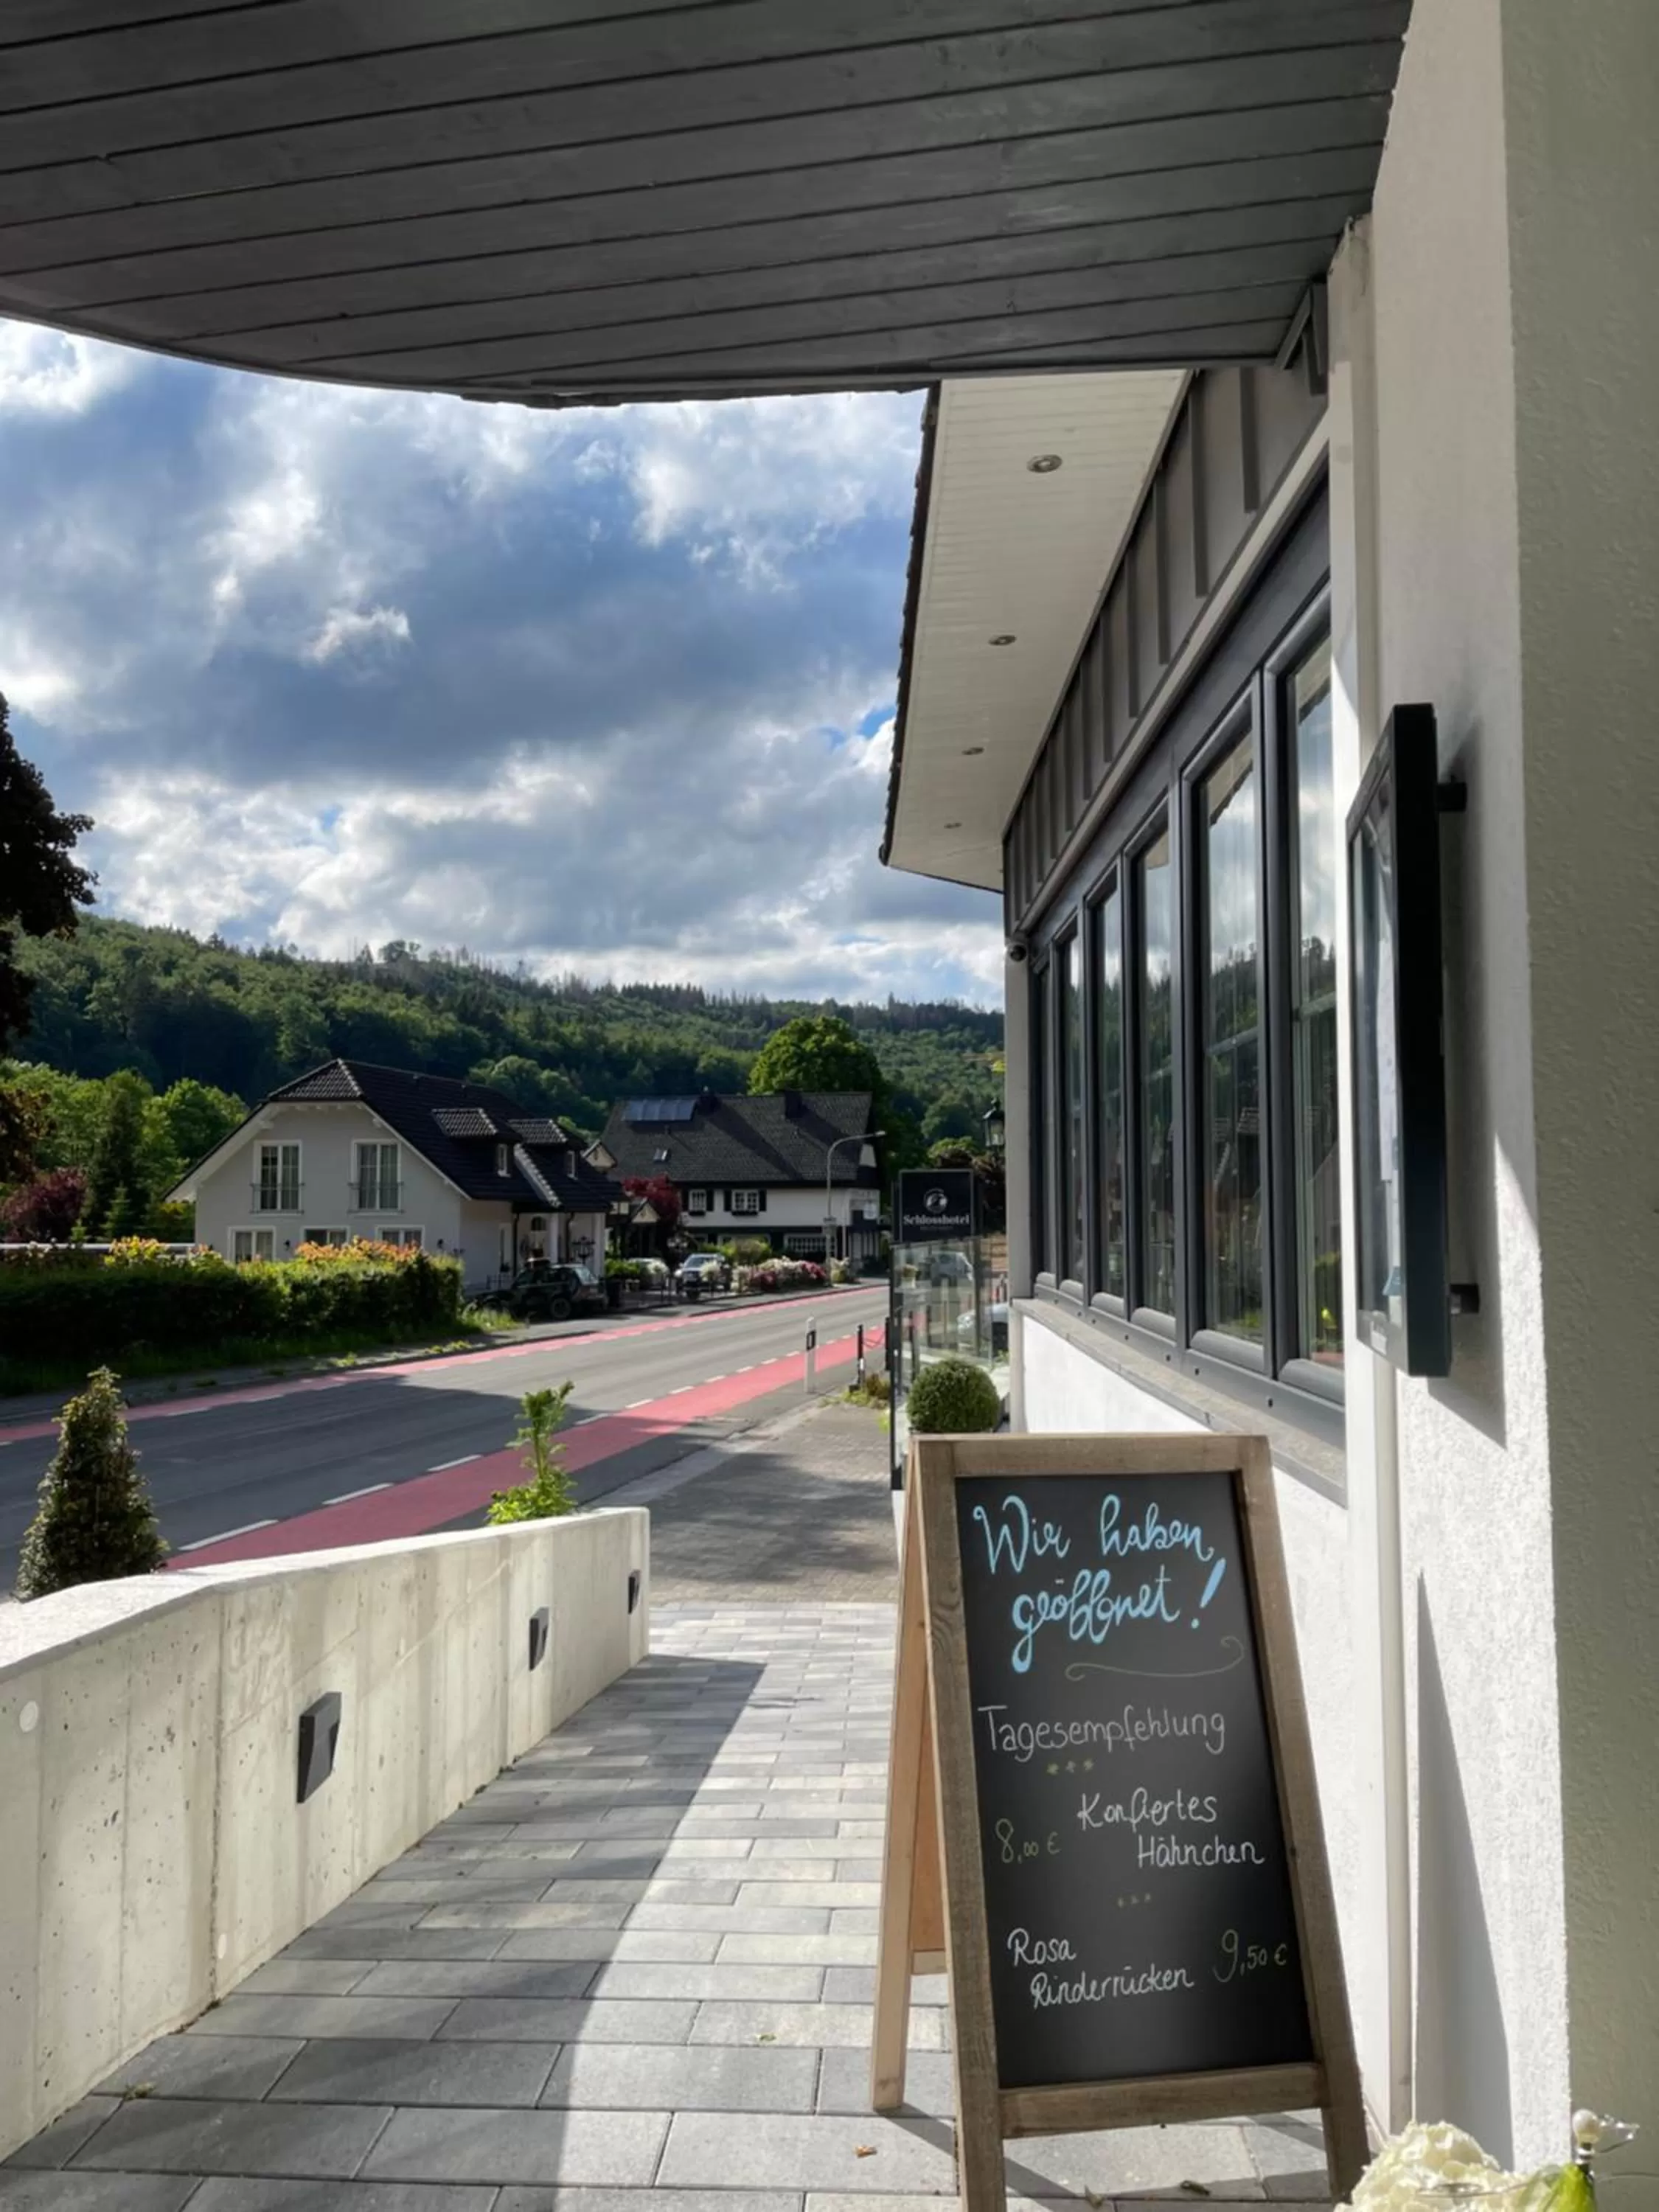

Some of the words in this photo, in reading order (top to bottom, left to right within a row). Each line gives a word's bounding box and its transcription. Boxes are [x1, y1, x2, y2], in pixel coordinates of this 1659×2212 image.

[973, 1495, 1071, 1573] Wir
[978, 1704, 1225, 1761] Tagesempfehlung
[1137, 1834, 1265, 1868] Hähnchen
[1007, 1927, 1077, 1967] Rosa
[1030, 1963, 1194, 2010] Rinderrücken
